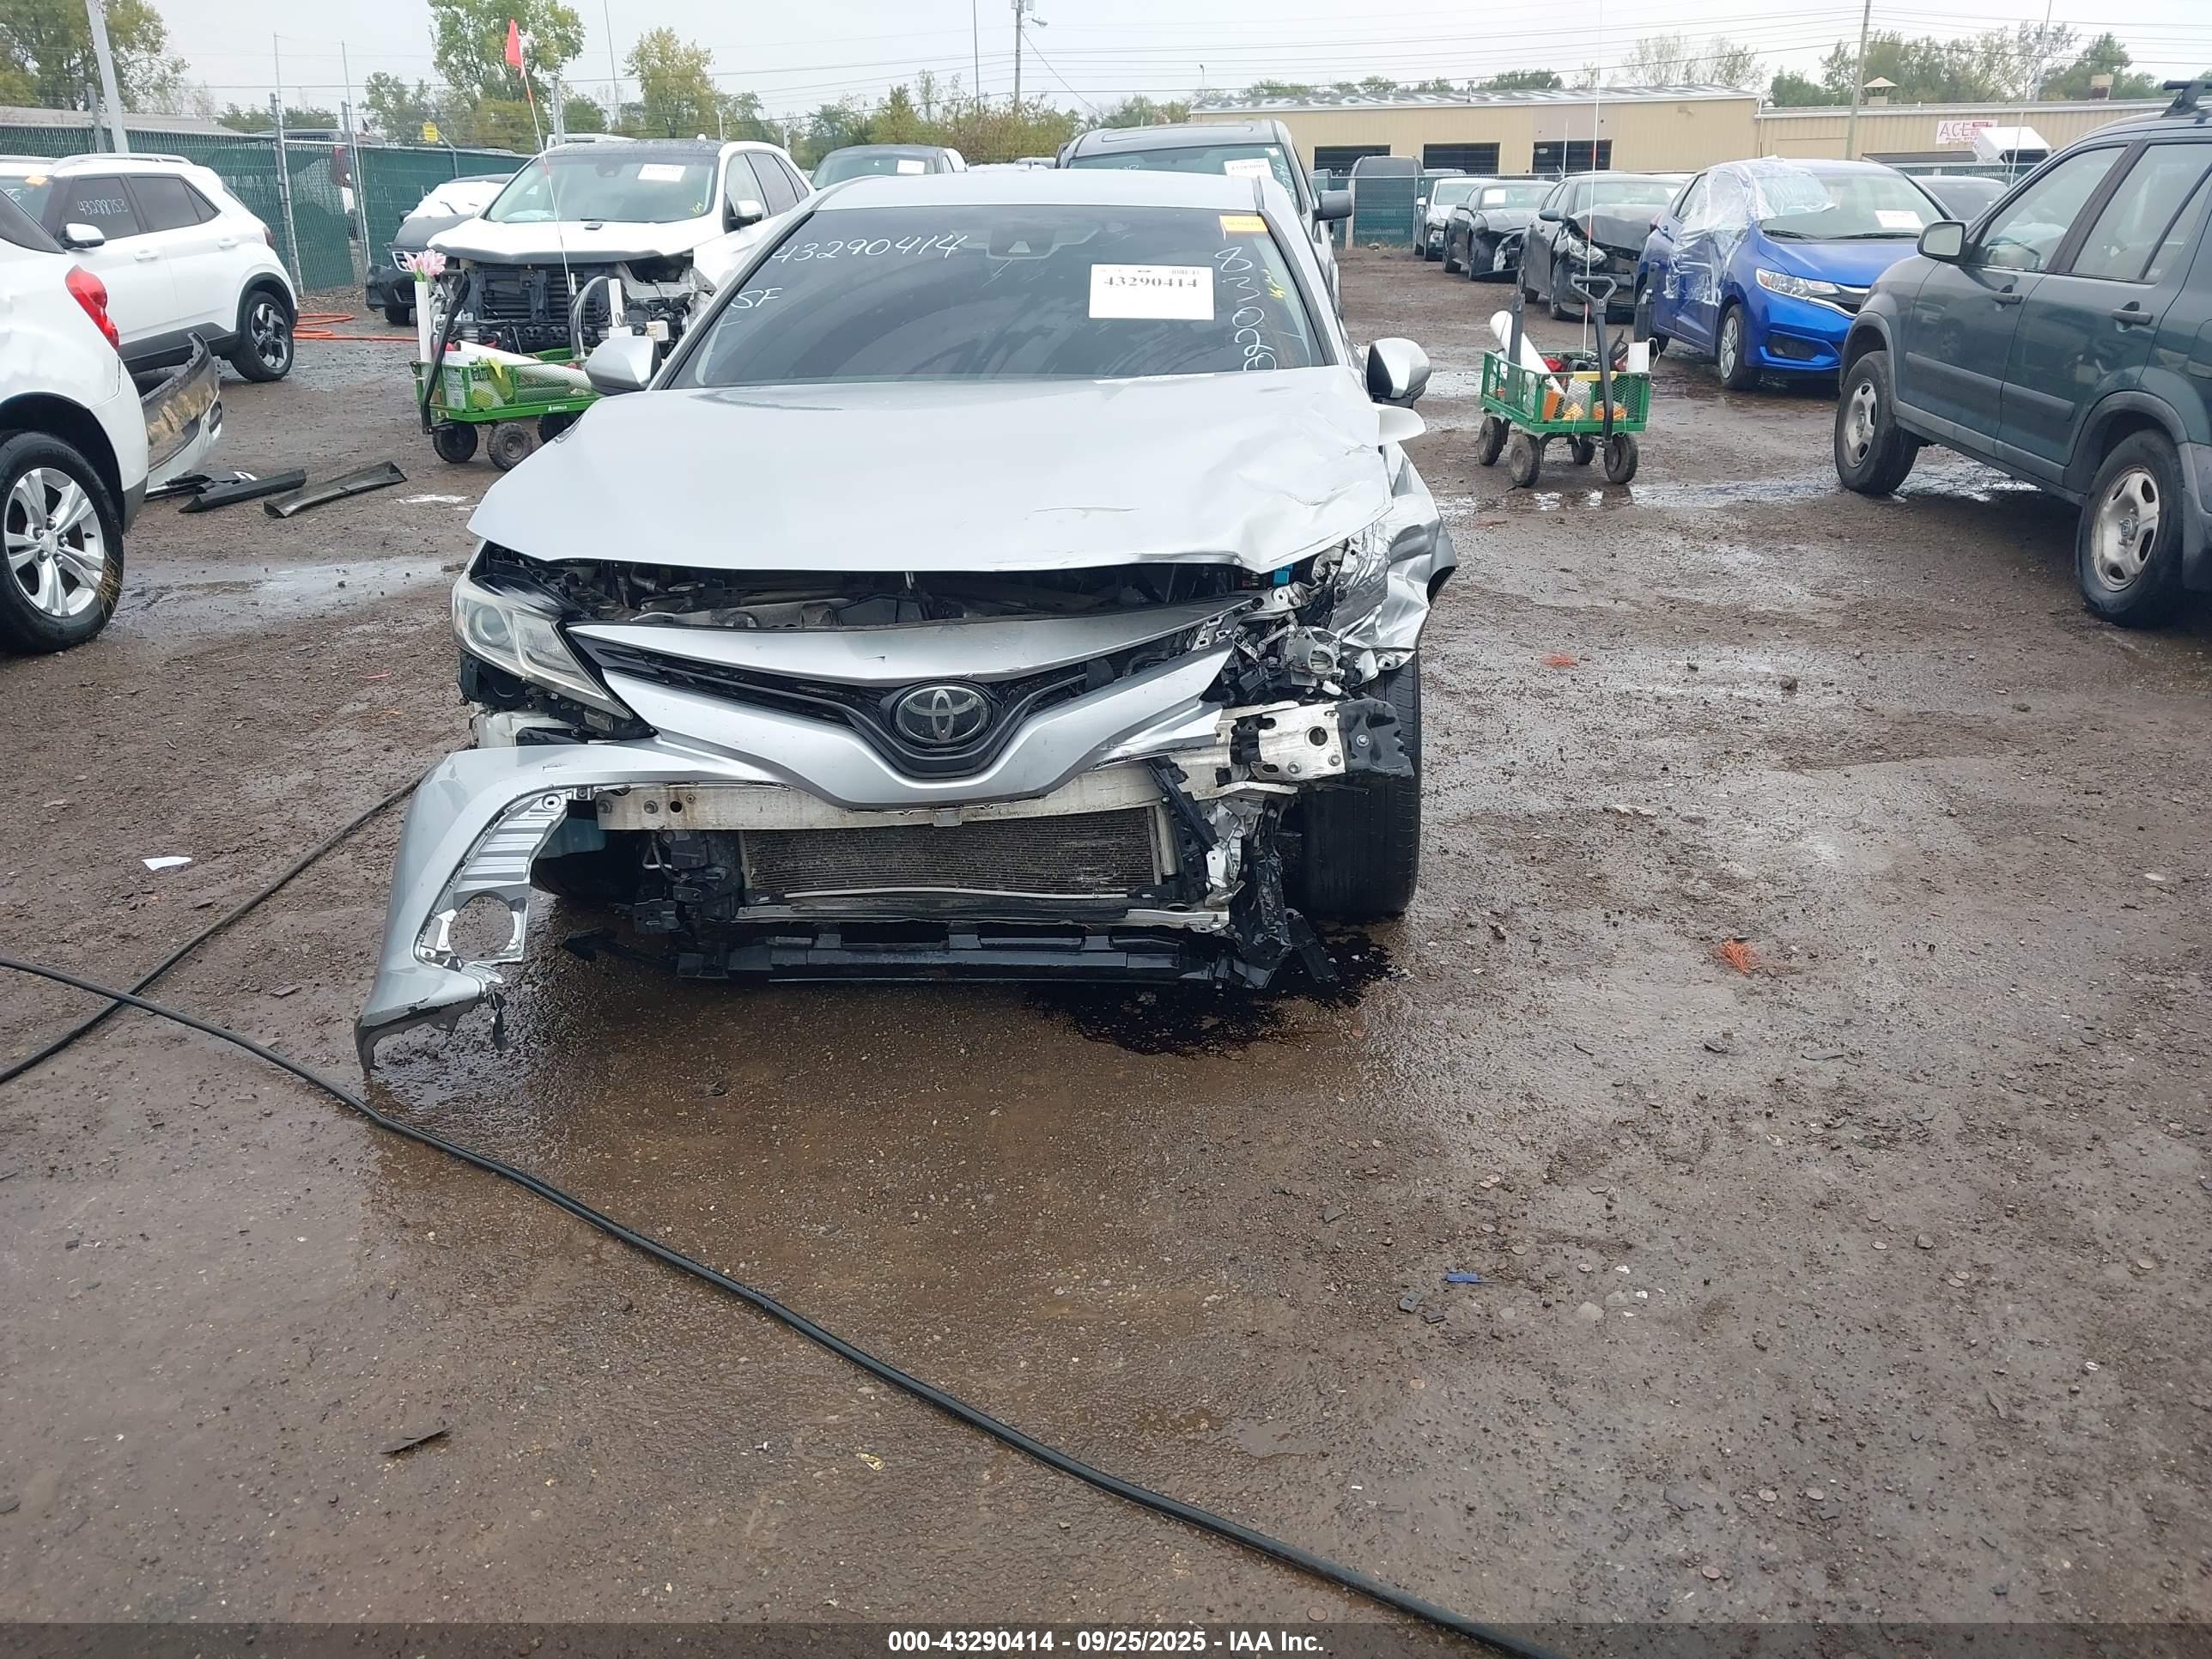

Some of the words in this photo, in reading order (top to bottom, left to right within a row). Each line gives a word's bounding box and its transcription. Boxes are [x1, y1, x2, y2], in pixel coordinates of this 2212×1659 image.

[772, 234, 969, 264] 43290414
[1103, 276, 1198, 288] 43290414
[730, 287, 783, 309] SF
